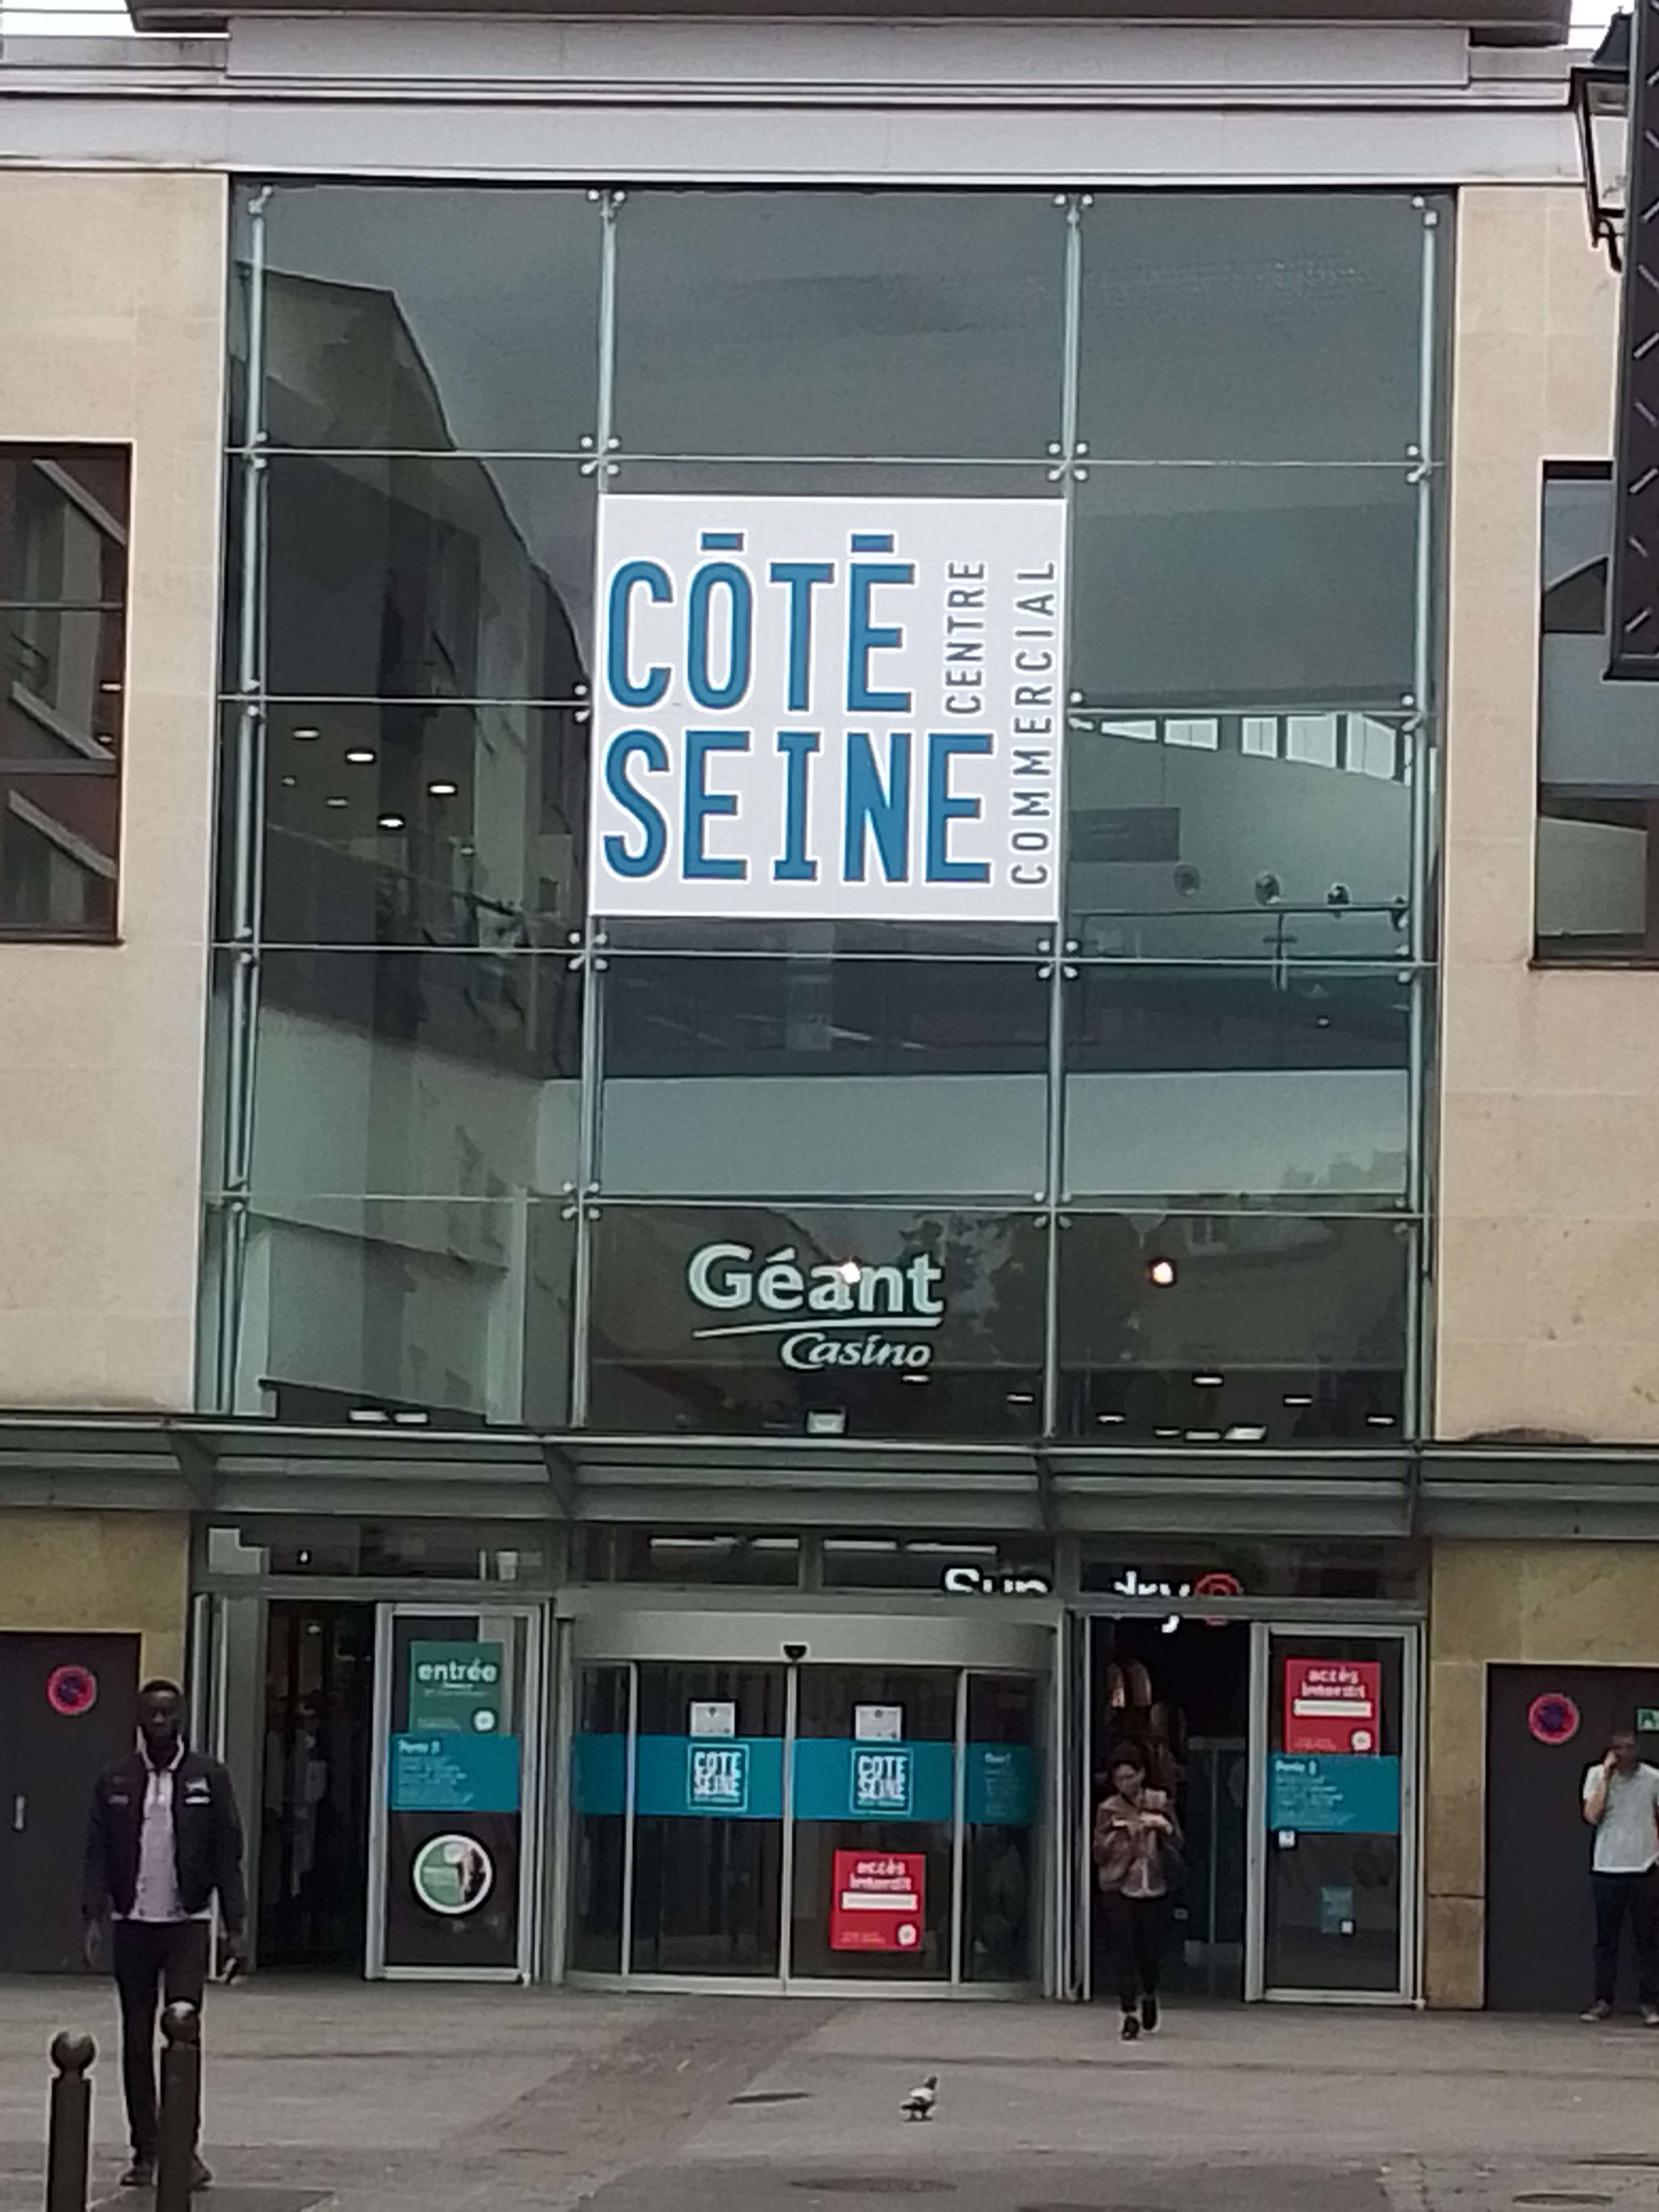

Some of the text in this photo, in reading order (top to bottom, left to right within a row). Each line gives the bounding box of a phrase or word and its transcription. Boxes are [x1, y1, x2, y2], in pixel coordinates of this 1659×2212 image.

[946, 562, 984, 714] CENTRE
[1011, 562, 1055, 885] COMMERCIAL
[604, 730, 994, 883] SEINE
[690, 1243, 944, 1314] Géant
[781, 1332, 932, 1369] Casino
[418, 1658, 497, 1682] entrée
